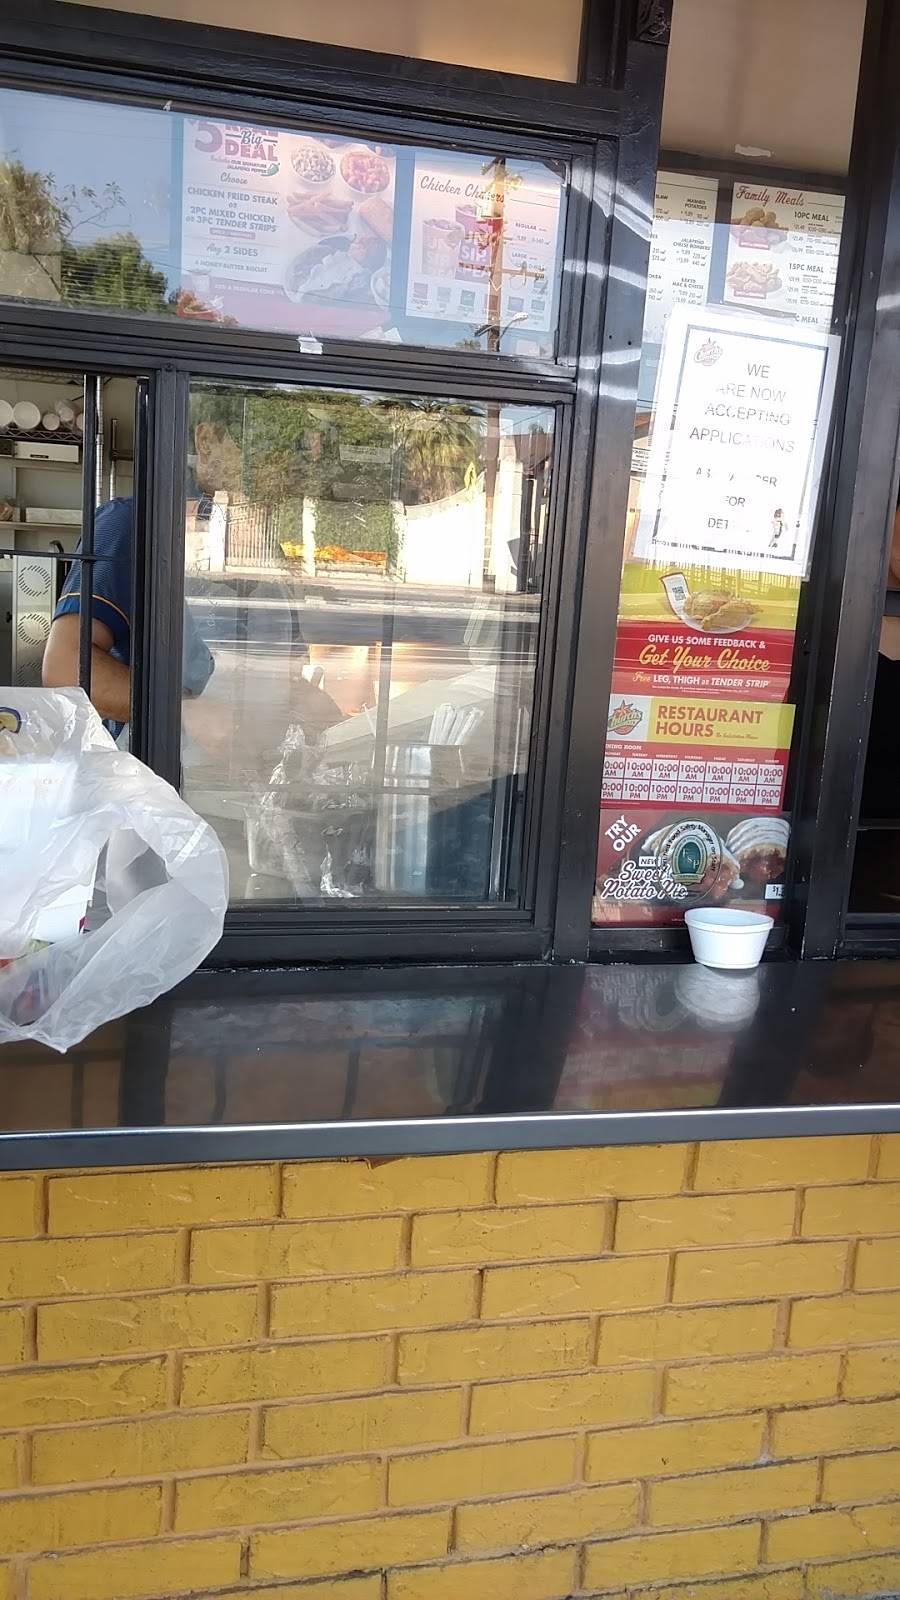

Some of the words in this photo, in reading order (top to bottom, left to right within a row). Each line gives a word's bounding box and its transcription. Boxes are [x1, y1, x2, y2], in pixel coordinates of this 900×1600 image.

[240, 130, 263, 150] Big
[224, 139, 278, 161] DEAL
[220, 171, 248, 184] Choose
[420, 175, 461, 195] Chicken
[187, 186, 225, 199] CHICKEN
[227, 191, 250, 201] FRIED
[252, 195, 278, 205] STEAK
[736, 185, 770, 207] Family
[775, 190, 804, 206] Meals
[190, 206, 207, 216] 2PC
[208, 208, 236, 219] MIXED
[238, 212, 275, 224] CHICKEN
[197, 216, 213, 225] 3PC
[215, 217, 248, 229] TENDER
[249, 222, 277, 232] STRIPS
[794, 211, 810, 220] 10PC
[811, 213, 831, 222] MEAL
[224, 246, 231, 254] 2
[233, 246, 258, 257] SIDES
[789, 262, 805, 271] 15PC
[806, 264, 824, 273] MEAL
[801, 315, 819, 324] MEAL
[747, 363, 770, 378] WE
[750, 386, 787, 402] NOW
[704, 403, 790, 426] ACCEPTING
[647, 634, 670, 643] GIVE
[671, 635, 684, 644] US
[685, 636, 711, 646] SOME
[713, 638, 757, 648] FEEDBACK
[759, 640, 766, 649] &
[639, 644, 670, 665] Get
[672, 645, 712, 674] Your
[717, 648, 771, 671] Choice
[653, 674, 671, 685] LEG,
[672, 675, 700, 685] THIGH
[711, 677, 743, 687] TENDER
[744, 679, 769, 688] STRIP
[657, 705, 764, 725] RESTAURANT
[655, 721, 714, 739] HOURS
[604, 761, 624, 770] 0:00
[627, 762, 652, 771] 10:00
[654, 763, 678, 772] 10:00
[680, 764, 705, 773] 10:00
[707, 765, 731, 774] 10:00
[733, 767, 757, 776] 10:00
[759, 768, 783, 777] 10:00
[602, 782, 622, 791] 0:00
[624, 783, 649, 792] 10:00
[651, 784, 676, 793] 10:00
[678, 785, 702, 794] 10:00
[704, 787, 728, 795] 10:00
[731, 788, 755, 796] 10:00
[757, 789, 780, 798] 10:00
[605, 815, 628, 839] TRY
[613, 824, 642, 851] OUR
[619, 860, 670, 882] Sweet
[601, 877, 657, 899] Potato
[657, 879, 688, 899] Pie
